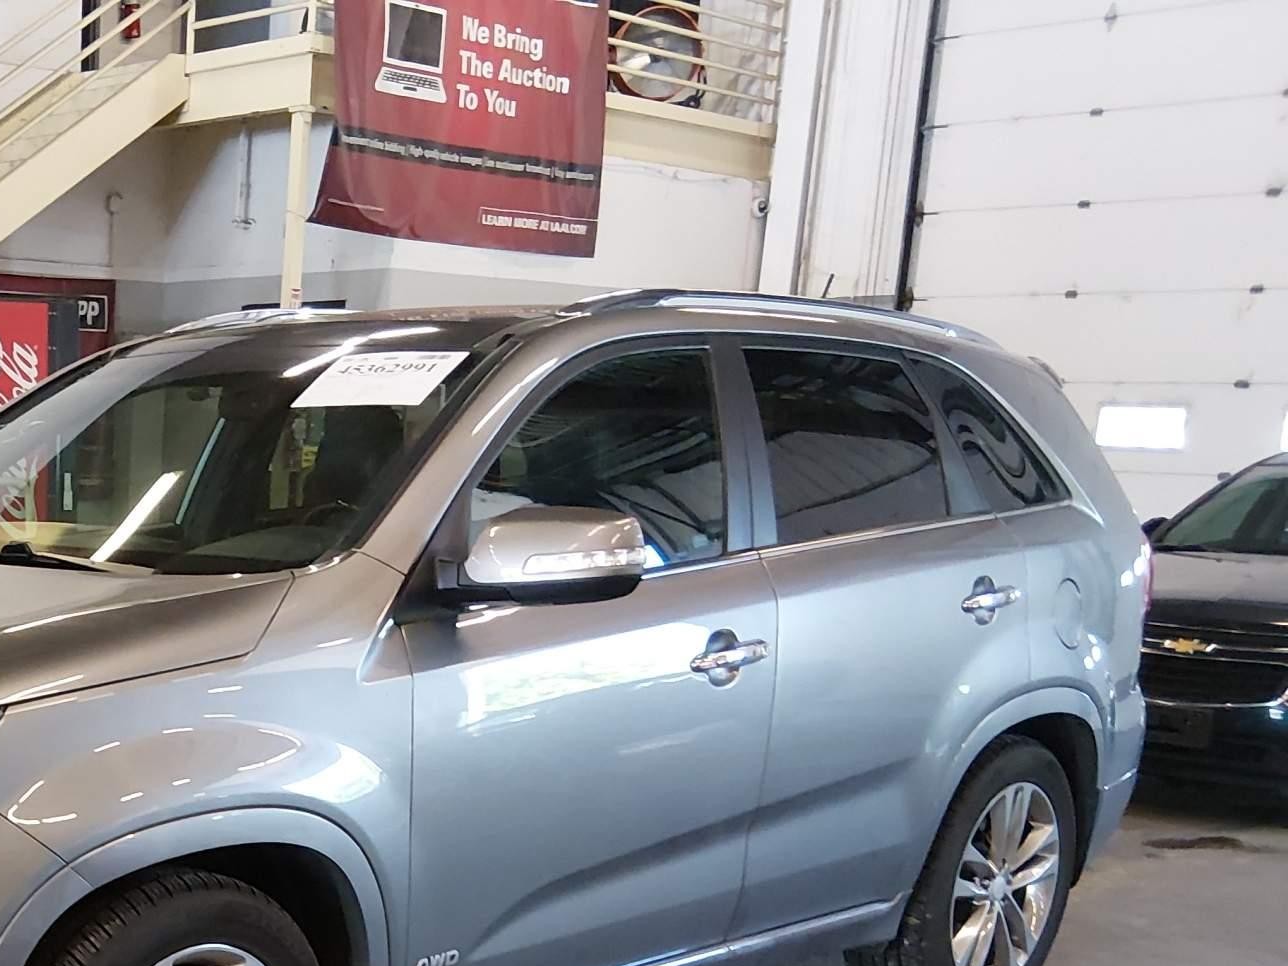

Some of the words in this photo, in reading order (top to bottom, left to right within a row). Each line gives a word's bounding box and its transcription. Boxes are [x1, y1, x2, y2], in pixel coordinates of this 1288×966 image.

[462, 15, 490, 44] We
[493, 24, 544, 61] Bring
[459, 50, 494, 79] The
[498, 59, 570, 94] Auction
[456, 84, 479, 111] To
[484, 88, 517, 117] You
